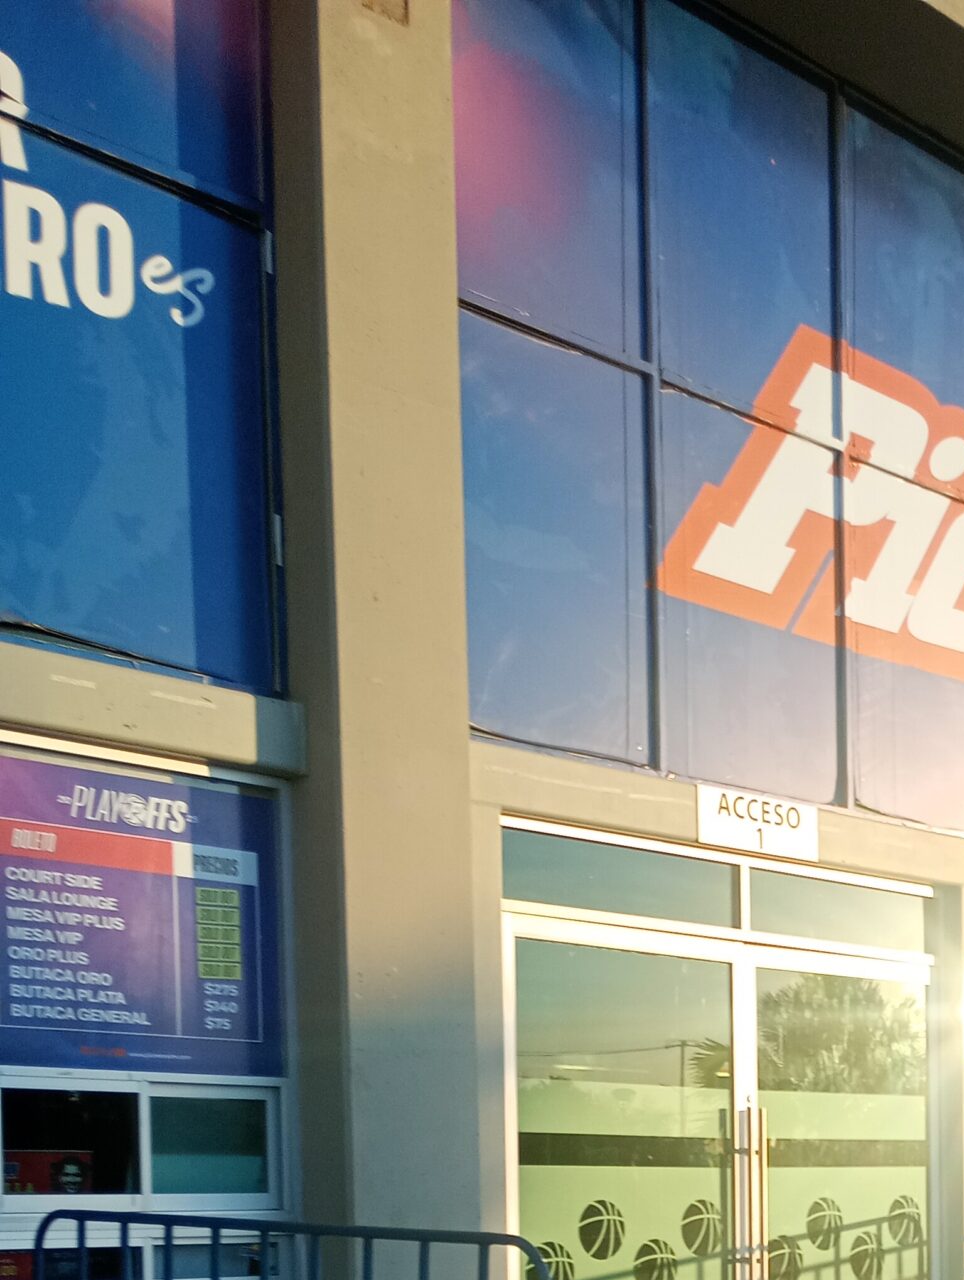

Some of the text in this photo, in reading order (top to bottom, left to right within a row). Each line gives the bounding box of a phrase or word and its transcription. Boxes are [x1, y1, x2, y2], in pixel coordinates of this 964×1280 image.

[718, 793, 800, 829] ACCESO
[756, 827, 763, 849] 1
[5, 866, 104, 890] COURT SIDE
[5, 886, 119, 911] SALA LOUNGE
[6, 906, 126, 931] MESA VIP PLUS
[7, 925, 84, 945] MESA VIP
[7, 946, 90, 965] ORO PLUS
[9, 965, 113, 986] BUTACA ORO
[9, 983, 127, 1005] BUTACA PLATA
[10, 1003, 152, 1026] BUTACA GENERAL
